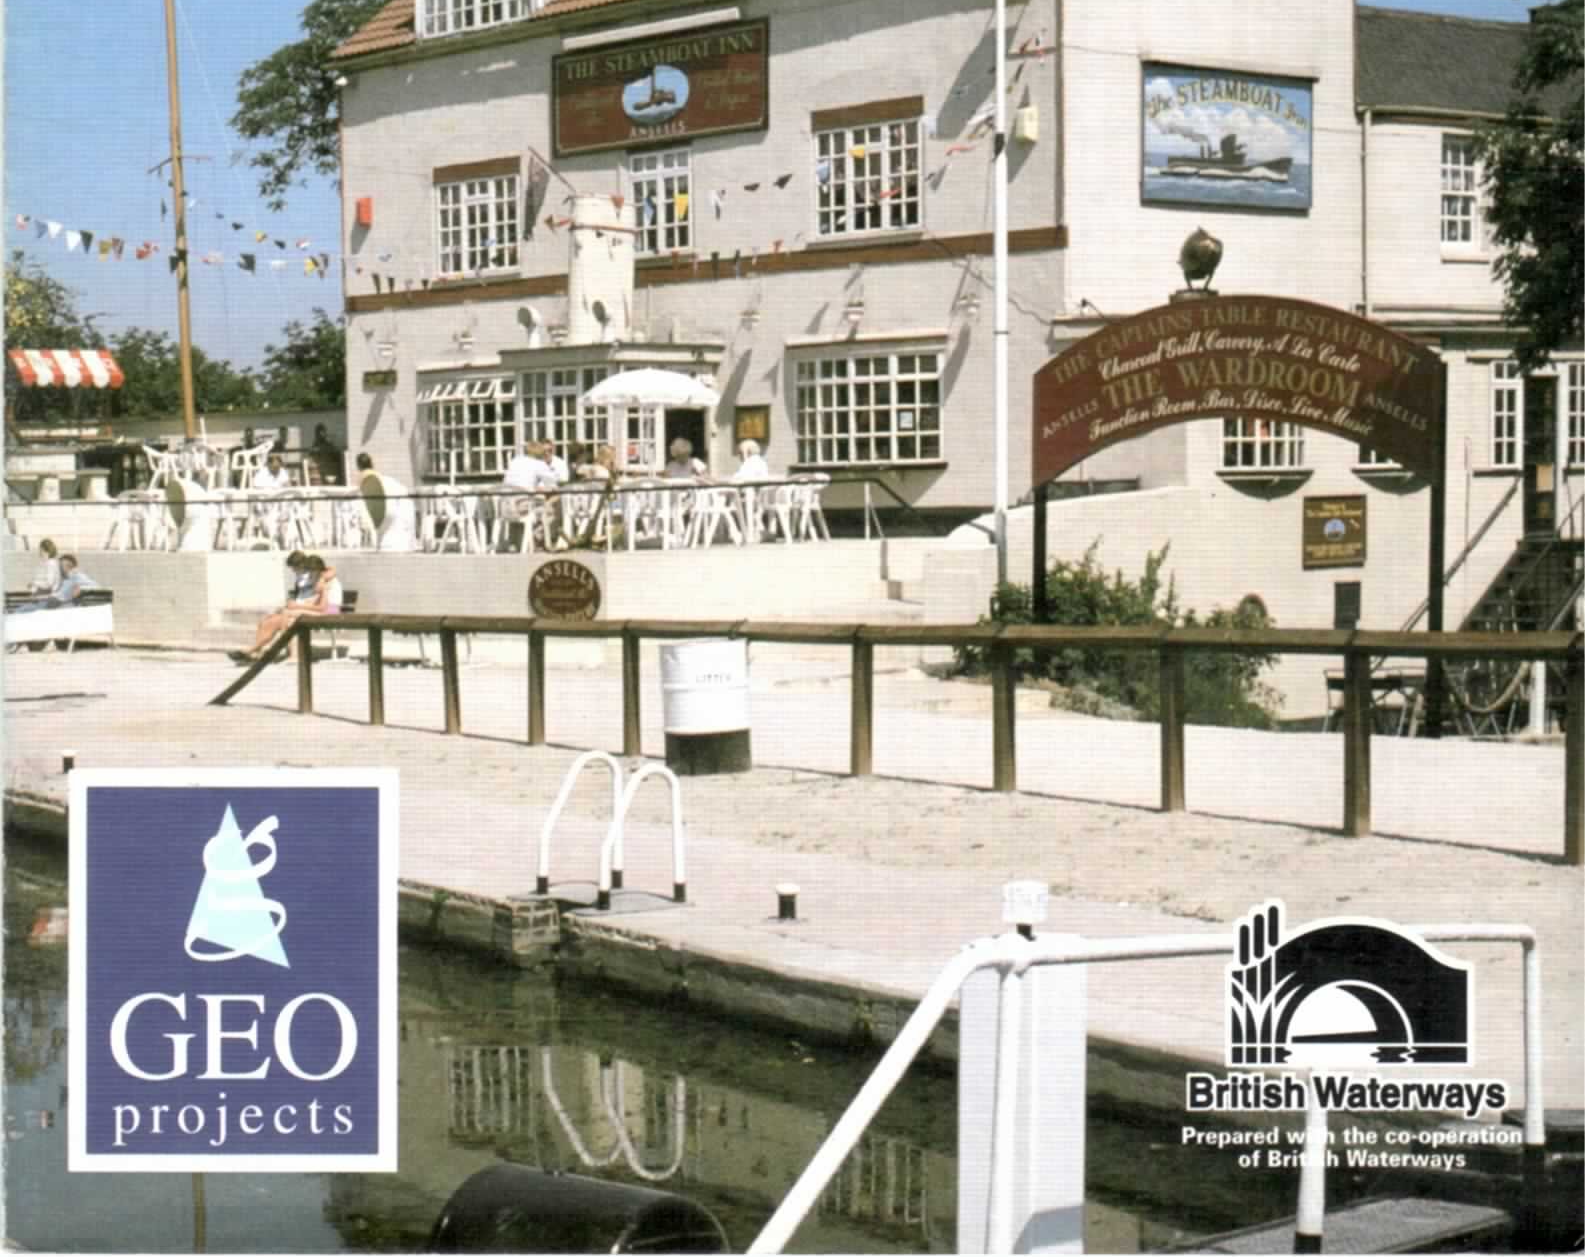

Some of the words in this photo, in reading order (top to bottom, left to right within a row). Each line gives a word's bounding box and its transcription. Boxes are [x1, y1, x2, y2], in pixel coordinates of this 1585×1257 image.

[567, 60, 597, 81] THE
[605, 39, 710, 73] STEAMBOAT
[719, 31, 754, 54] INN
[1176, 76, 1282, 113] STEAMBOAT
[1054, 351, 1091, 384] THE
[1095, 309, 1192, 359] CAPTAINS
[1203, 304, 1267, 326] TABLE
[1276, 308, 1420, 375] RESTAURANT
[1102, 368, 1163, 409] THE
[1176, 355, 1361, 408] WARDROOM
[110, 992, 358, 1081] GEO
[112, 1091, 354, 1147] projects
[1188, 1074, 1306, 1110] British
[1312, 1075, 1507, 1117] Waterways
[1181, 1126, 1279, 1149] Prepared
[1343, 1126, 1377, 1145] the
[1385, 1126, 1524, 1149] co-operation
[1238, 1150, 1262, 1168] of
[1347, 1150, 1467, 1170] Waterways
